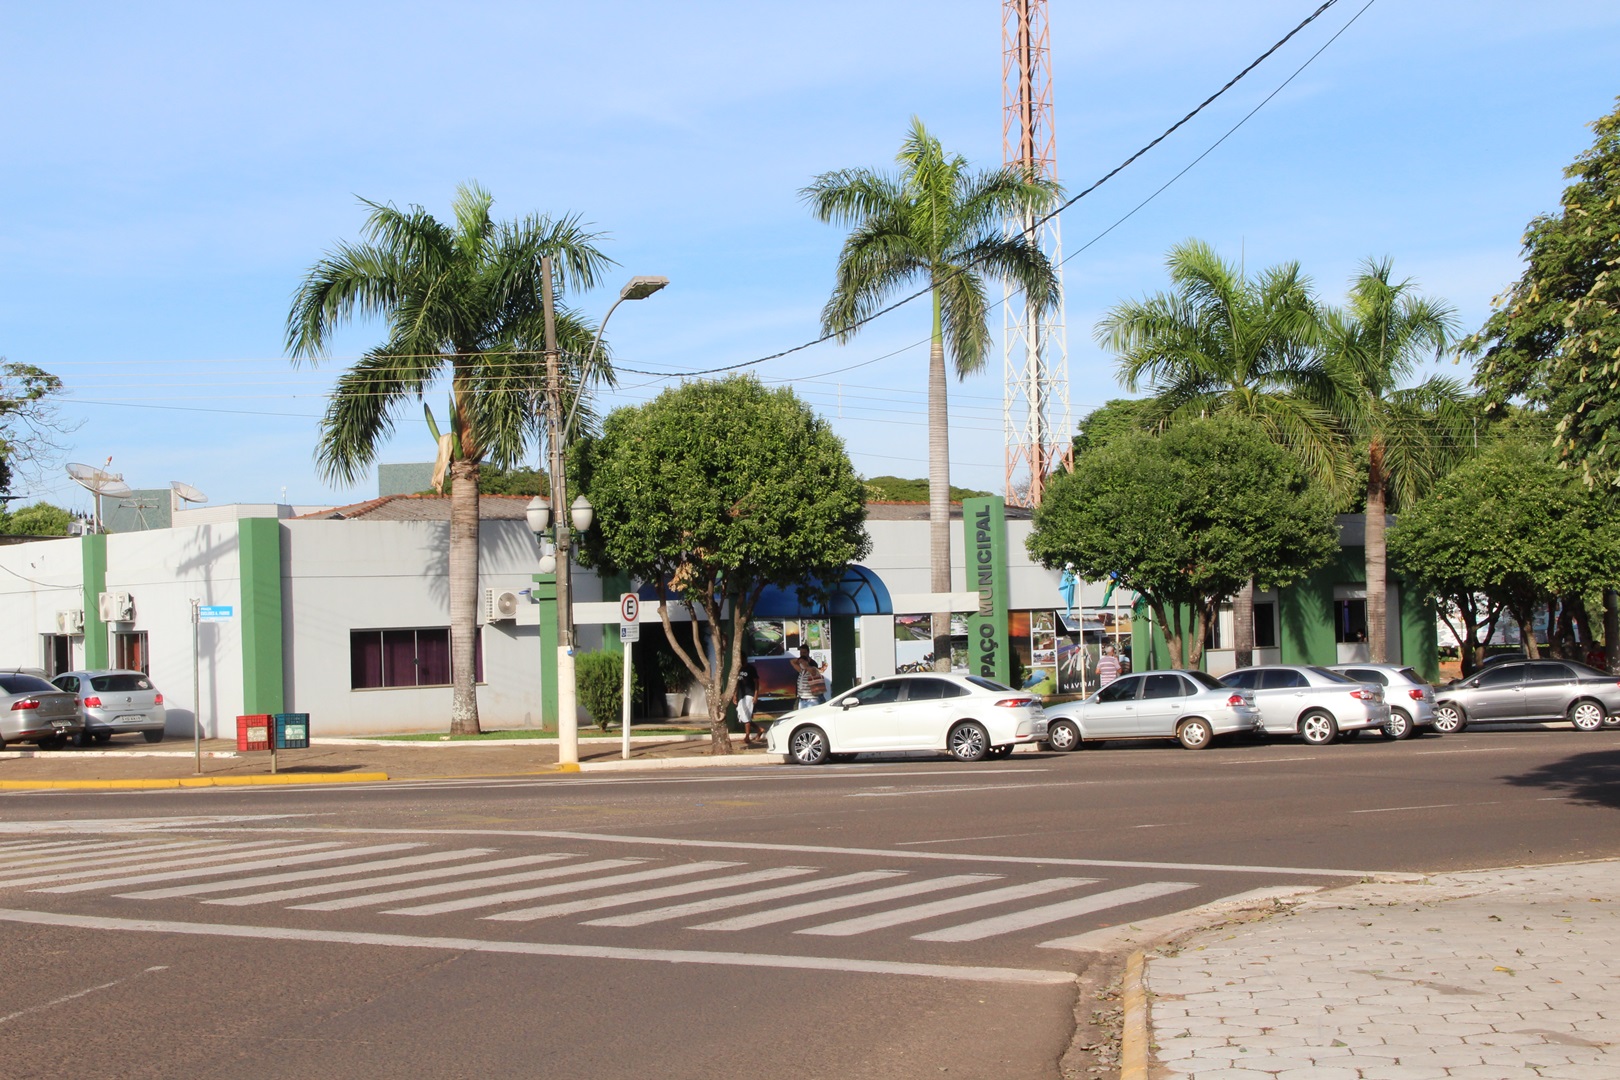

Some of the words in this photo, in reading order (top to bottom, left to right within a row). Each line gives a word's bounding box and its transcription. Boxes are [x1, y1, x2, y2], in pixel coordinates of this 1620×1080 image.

[976, 505, 993, 617] MUNICIPAL
[627, 600, 634, 615] E
[979, 623, 998, 677] PAÇO
